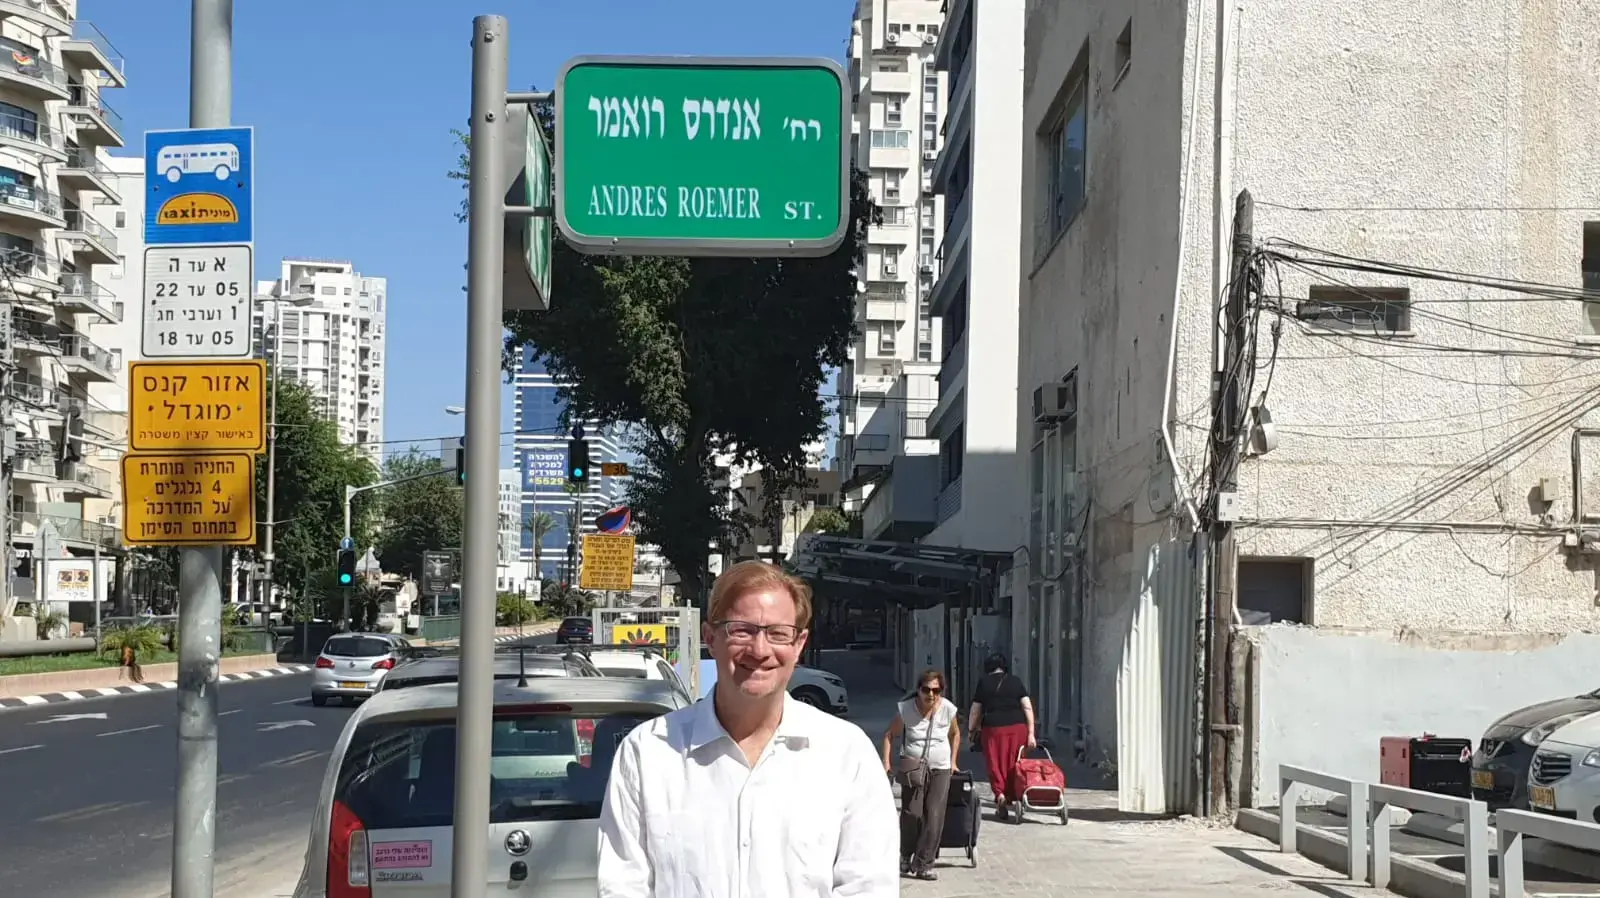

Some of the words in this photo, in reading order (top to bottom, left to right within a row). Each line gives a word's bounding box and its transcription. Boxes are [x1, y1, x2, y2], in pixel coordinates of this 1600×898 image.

[588, 95, 665, 140] רואמר
[682, 96, 761, 141] אנדרס
[588, 185, 667, 217] ANDRES
[678, 188, 761, 219] ROEMER
[783, 201, 822, 220] ST.
[164, 202, 195, 219] taxi
[199, 209, 231, 217] מונית
[169, 257, 180, 273] ה
[188, 261, 206, 272] עד
[214, 256, 226, 272] א
[155, 283, 179, 297] 22
[188, 285, 206, 296] עד
[216, 281, 239, 297] 05
[157, 309, 174, 321] חג
[182, 309, 222, 321] וערבי
[158, 332, 178, 346] 18
[186, 333, 204, 345] עד
[212, 331, 234, 345] 05
[143, 376, 188, 396] קנס
[201, 375, 250, 392] אזור
[163, 400, 231, 420] מוגדל
[139, 430, 180, 439] משטרה
[186, 430, 209, 441] קצין
[215, 430, 254, 439] באישור
[528, 452, 565, 461] להשכרה
[140, 462, 184, 476] מותרת
[194, 460, 235, 474] החניה
[155, 480, 202, 495] גלגלים
[212, 480, 222, 494] 4
[146, 502, 202, 515] המדרכה
[213, 499, 231, 515] על
[140, 521, 183, 537] הסימן
[192, 521, 237, 535] בתחום
